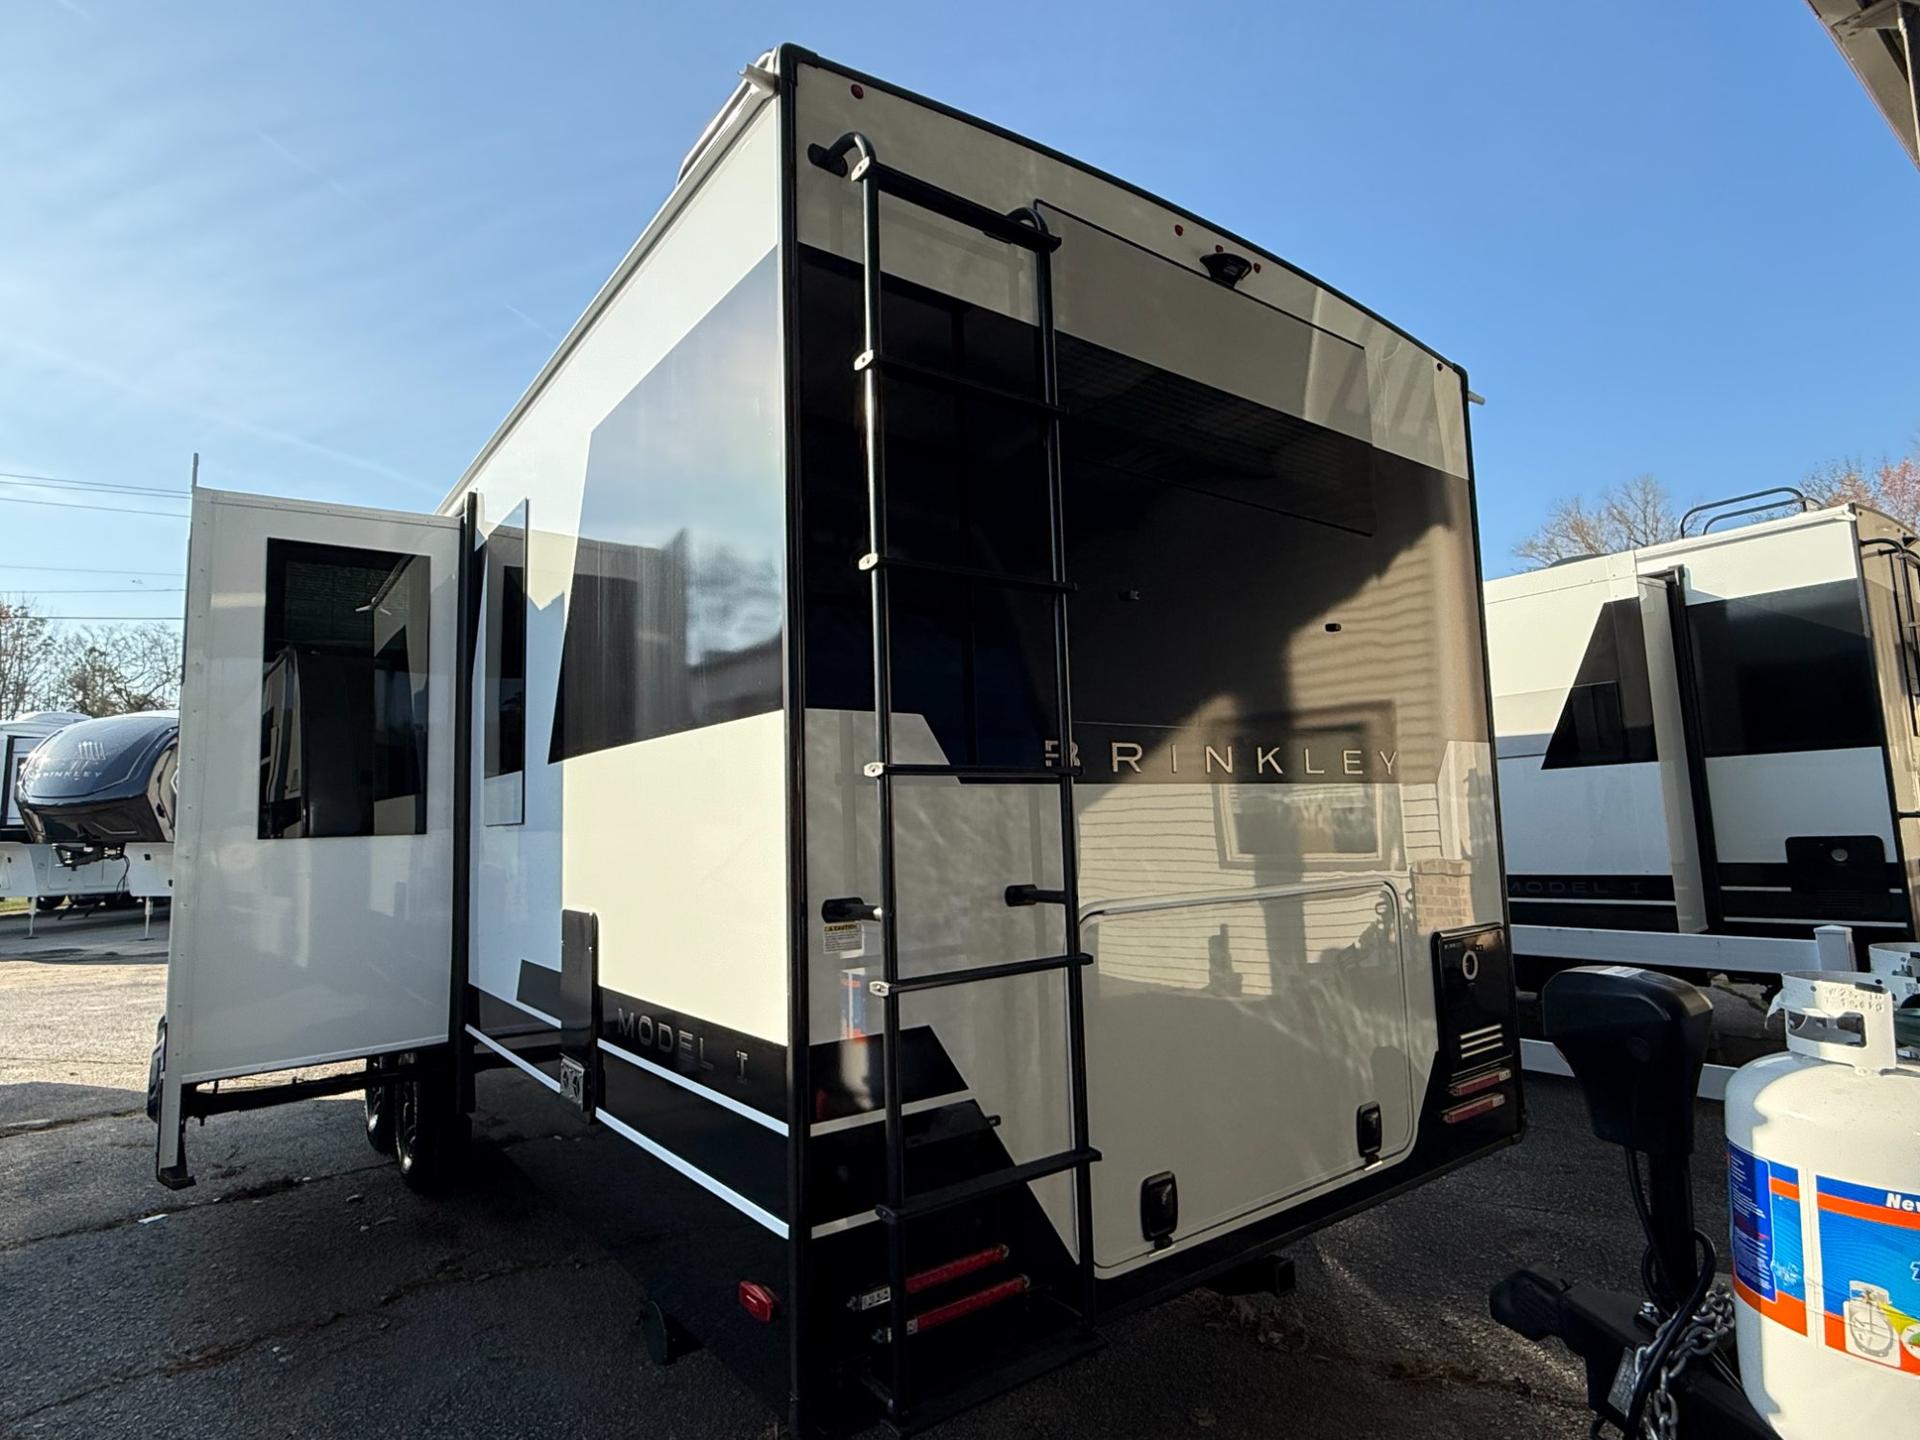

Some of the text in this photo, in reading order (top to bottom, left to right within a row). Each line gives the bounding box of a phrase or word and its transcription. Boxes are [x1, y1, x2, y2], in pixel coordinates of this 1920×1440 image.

[1045, 739, 1398, 775] BRINKLEY
[617, 1007, 749, 1085] MODEL T
